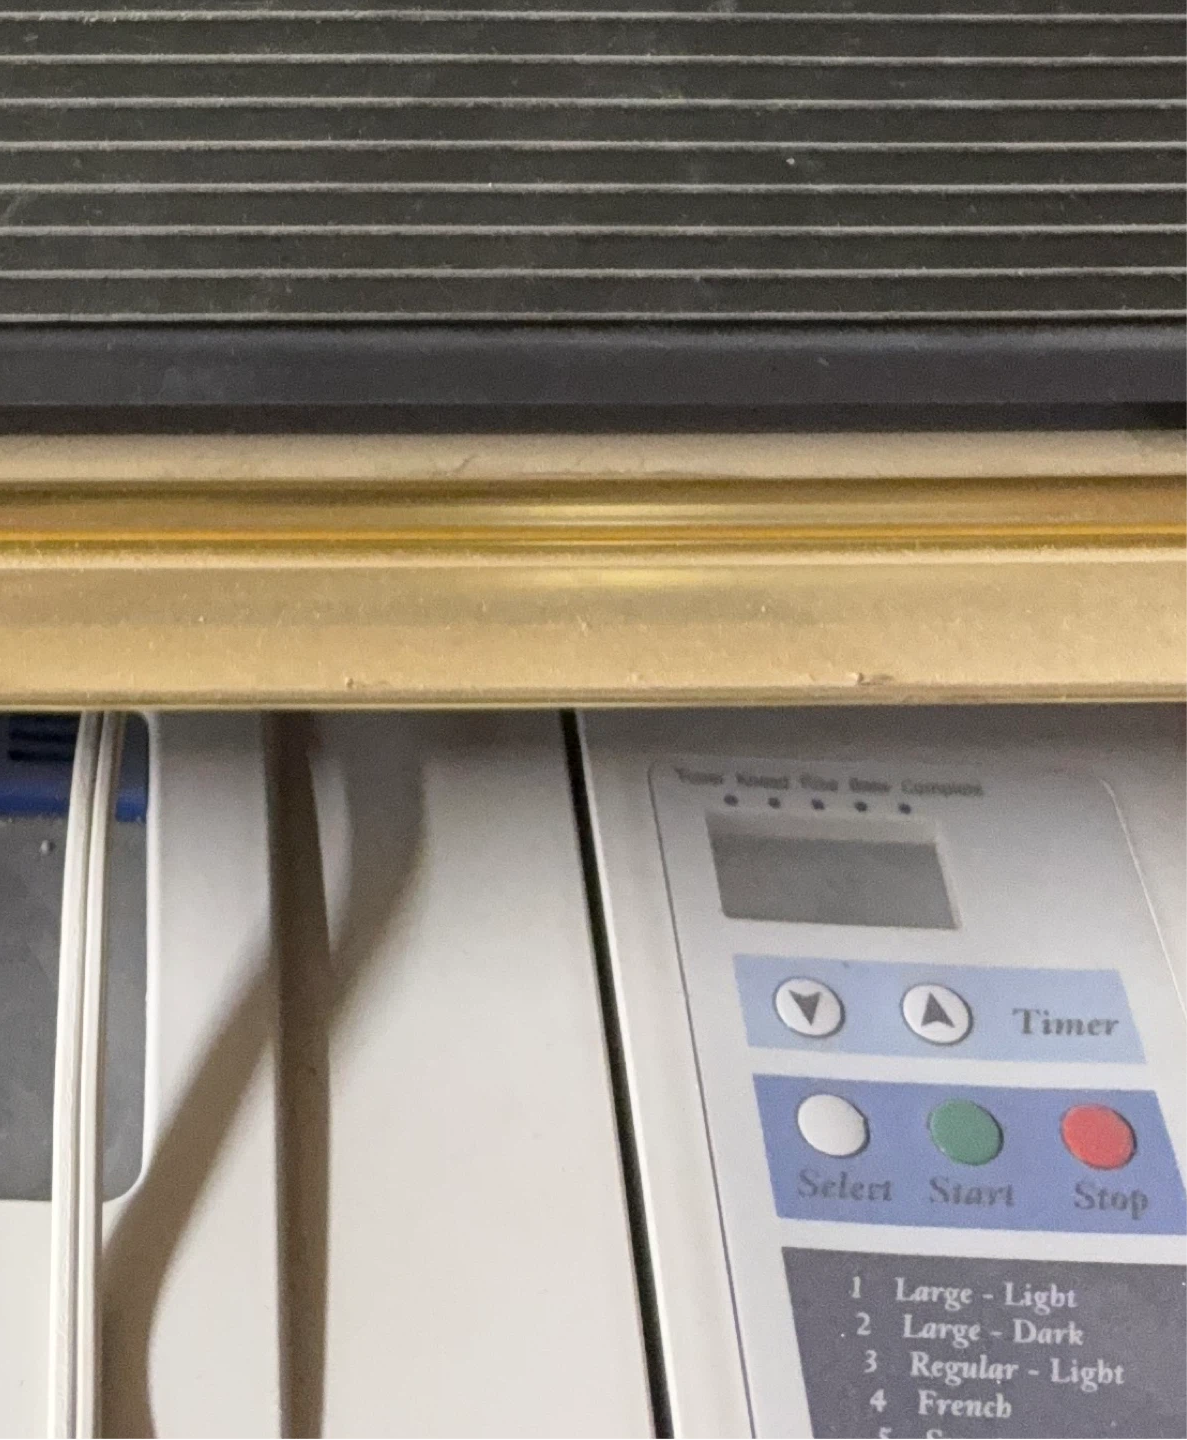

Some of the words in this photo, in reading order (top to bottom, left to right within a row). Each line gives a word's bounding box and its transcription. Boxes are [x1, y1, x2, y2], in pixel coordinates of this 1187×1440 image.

[1012, 1008, 1119, 1036] Timer
[797, 1169, 893, 1203] Select
[929, 1176, 1014, 1208] Start
[1073, 1178, 1149, 1220] Stop
[852, 1276, 862, 1299] 1
[894, 1277, 972, 1312] Large
[1004, 1282, 1078, 1316] Light
[856, 1312, 871, 1336] 2
[903, 1314, 981, 1349] Large
[1014, 1318, 1084, 1345] Dark
[864, 1350, 878, 1373] 3
[910, 1351, 1019, 1387] Regular
[1050, 1358, 1125, 1393] Light
[870, 1389, 887, 1412] 4
[918, 1390, 1012, 1419] French
